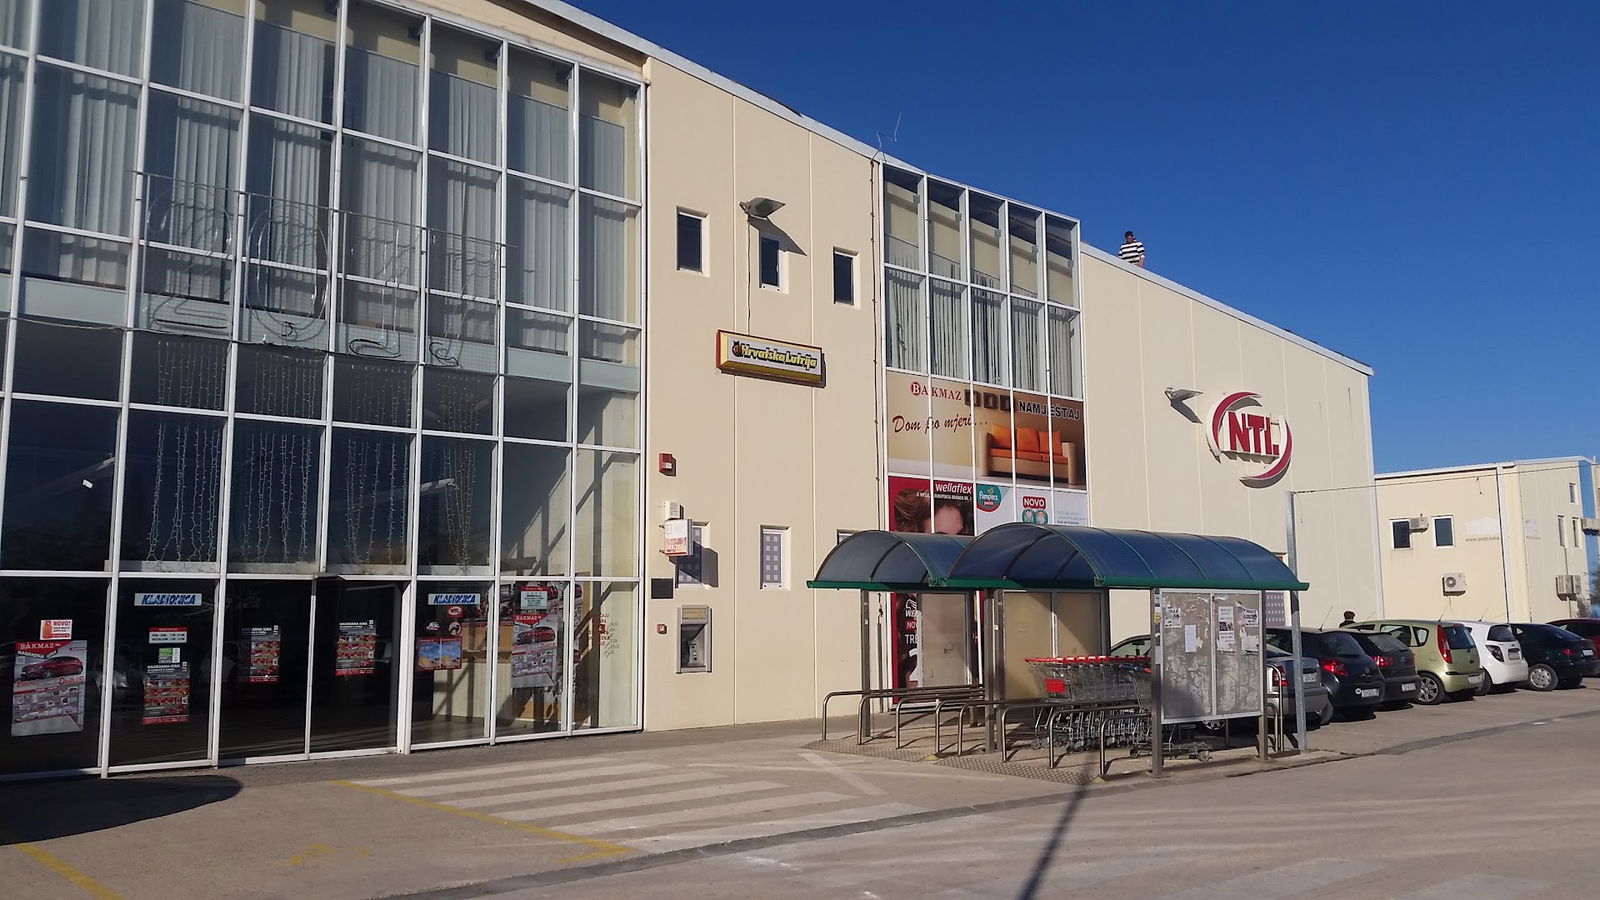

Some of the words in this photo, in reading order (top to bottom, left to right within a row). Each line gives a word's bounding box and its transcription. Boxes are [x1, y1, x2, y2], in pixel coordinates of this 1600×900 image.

[741, 342, 785, 364] Hrvatska
[784, 350, 818, 371] Lutrija
[911, 381, 962, 402] BAKMAZ
[892, 415, 921, 433] Dom
[925, 417, 940, 434] po
[935, 482, 973, 495] wellaflex
[1023, 497, 1045, 508] NOVO
